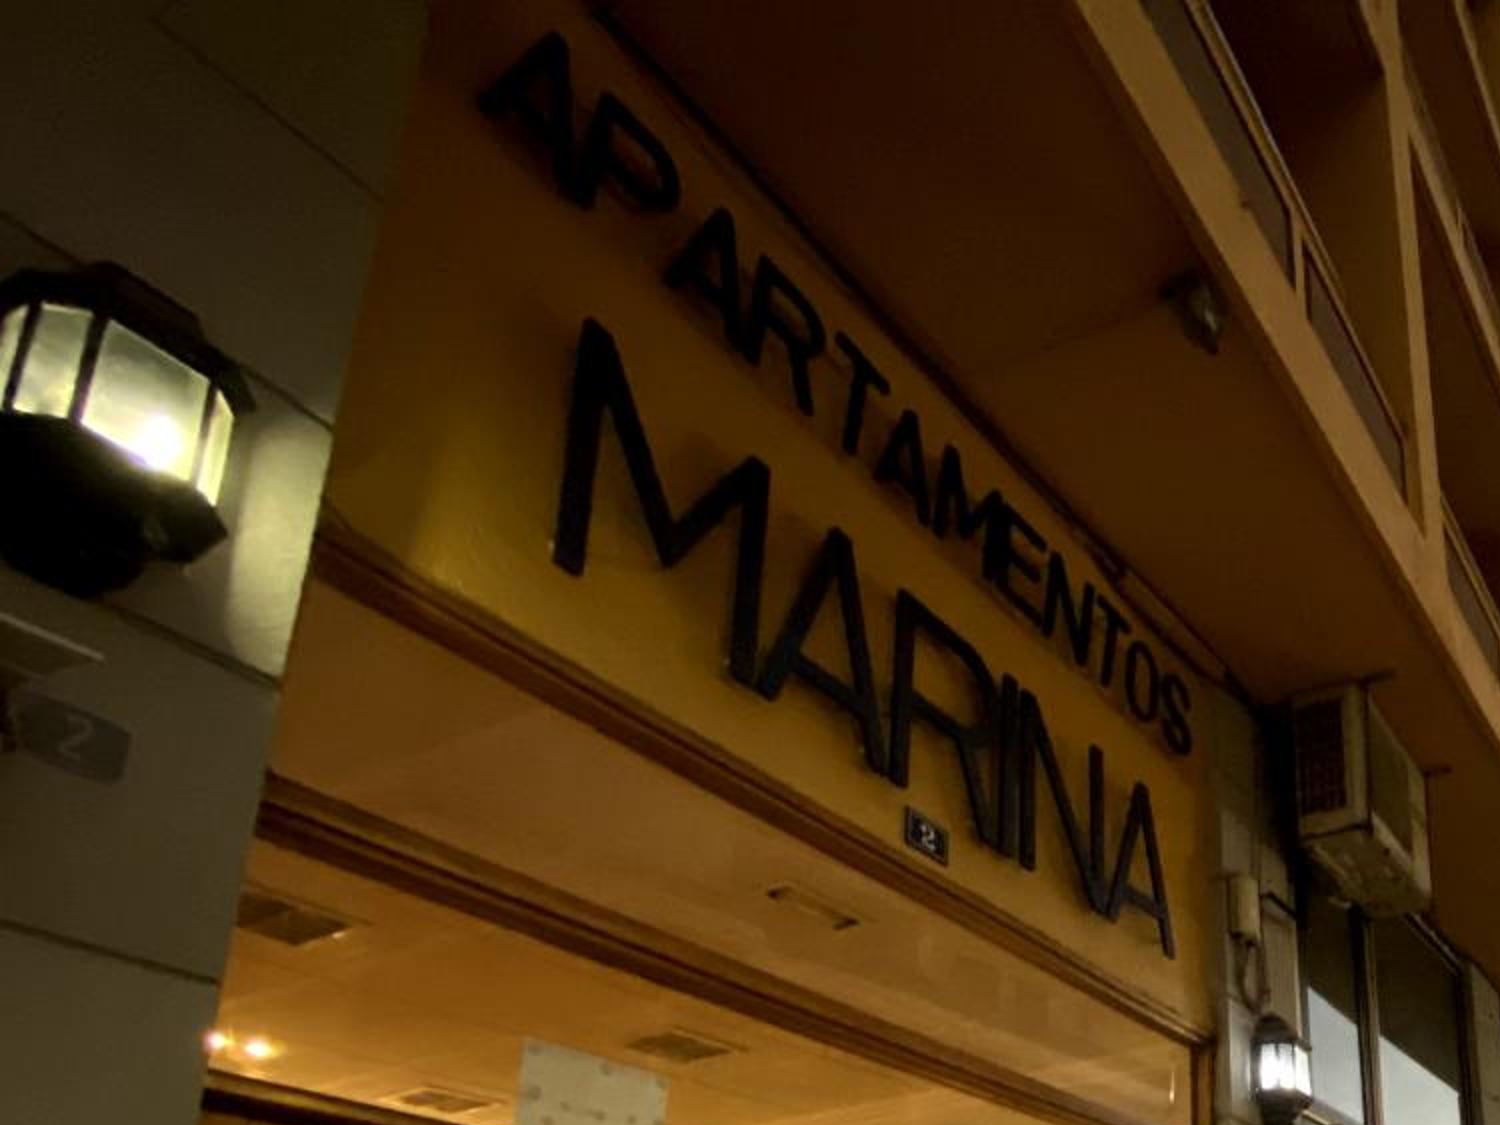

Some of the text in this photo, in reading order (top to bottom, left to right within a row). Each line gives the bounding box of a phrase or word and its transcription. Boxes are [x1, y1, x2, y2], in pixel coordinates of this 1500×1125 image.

[478, 32, 1192, 757] APARTAMENTOS
[552, 317, 1175, 960] MARINA
[920, 823, 936, 852] 2
